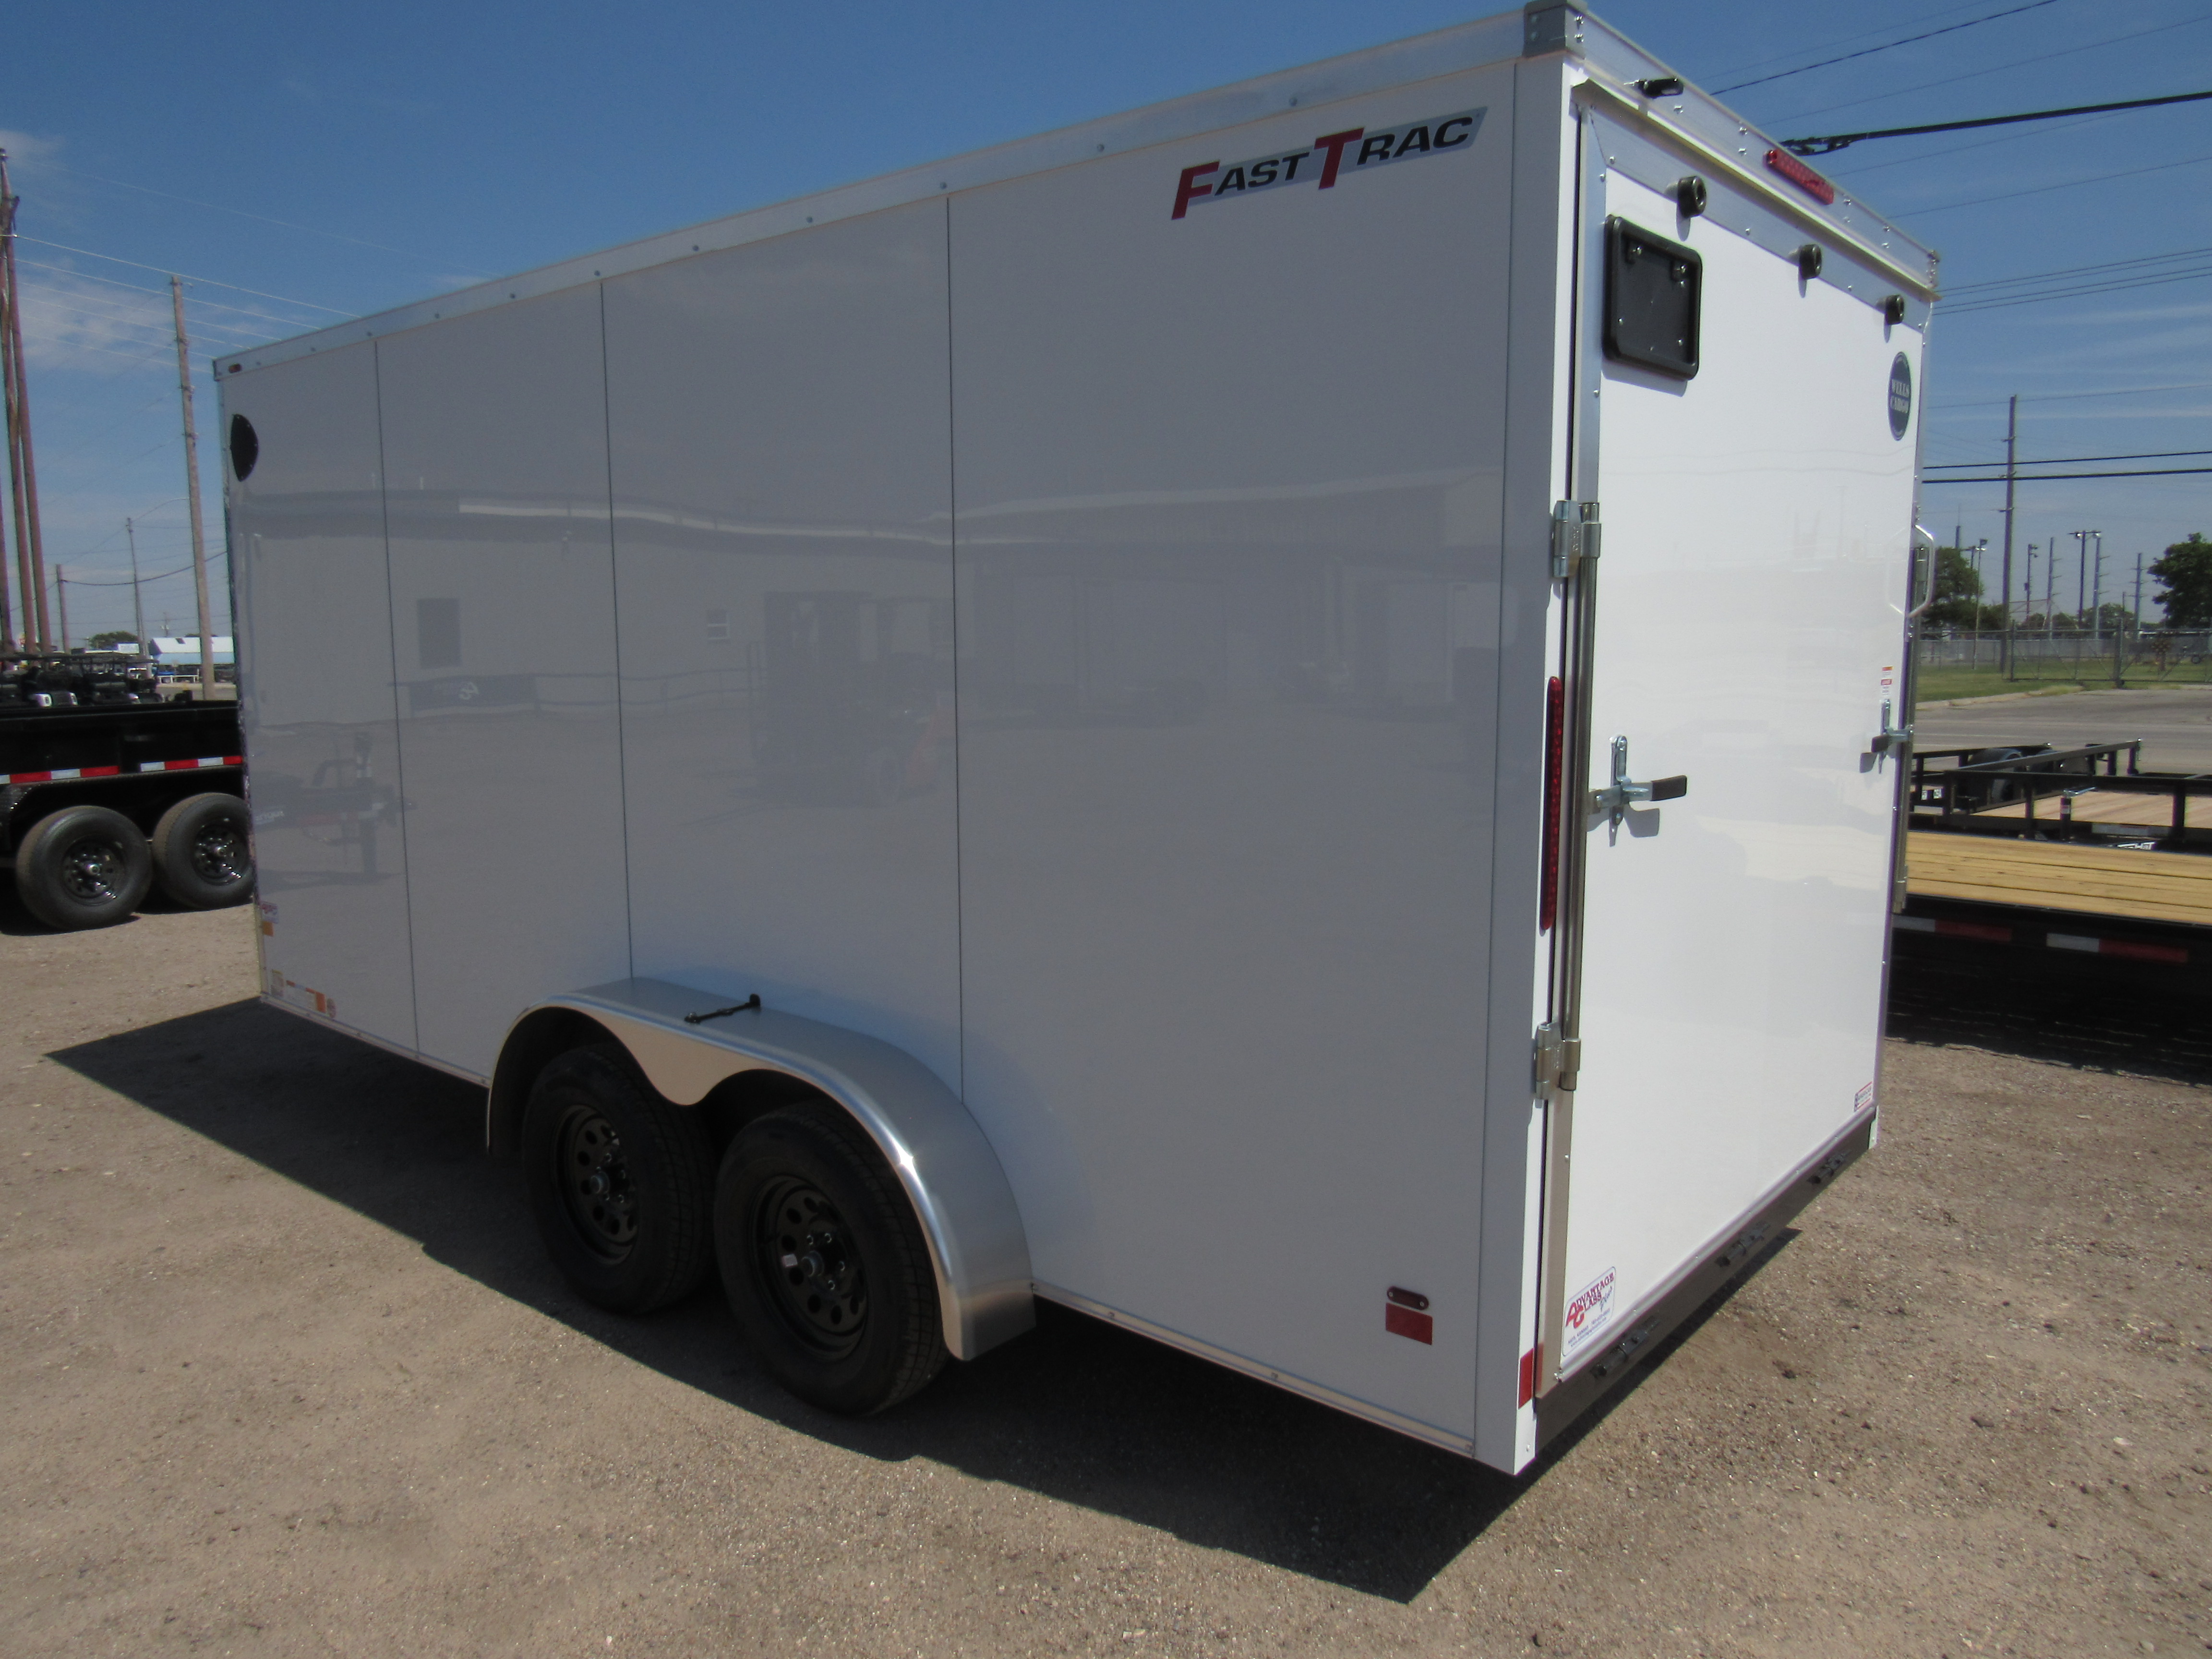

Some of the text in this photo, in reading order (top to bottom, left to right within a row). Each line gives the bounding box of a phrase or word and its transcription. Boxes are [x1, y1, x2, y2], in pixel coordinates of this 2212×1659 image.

[1171, 116, 1473, 220] FAST TRAC
[1565, 1272, 1614, 1327] ADVANTAGE
